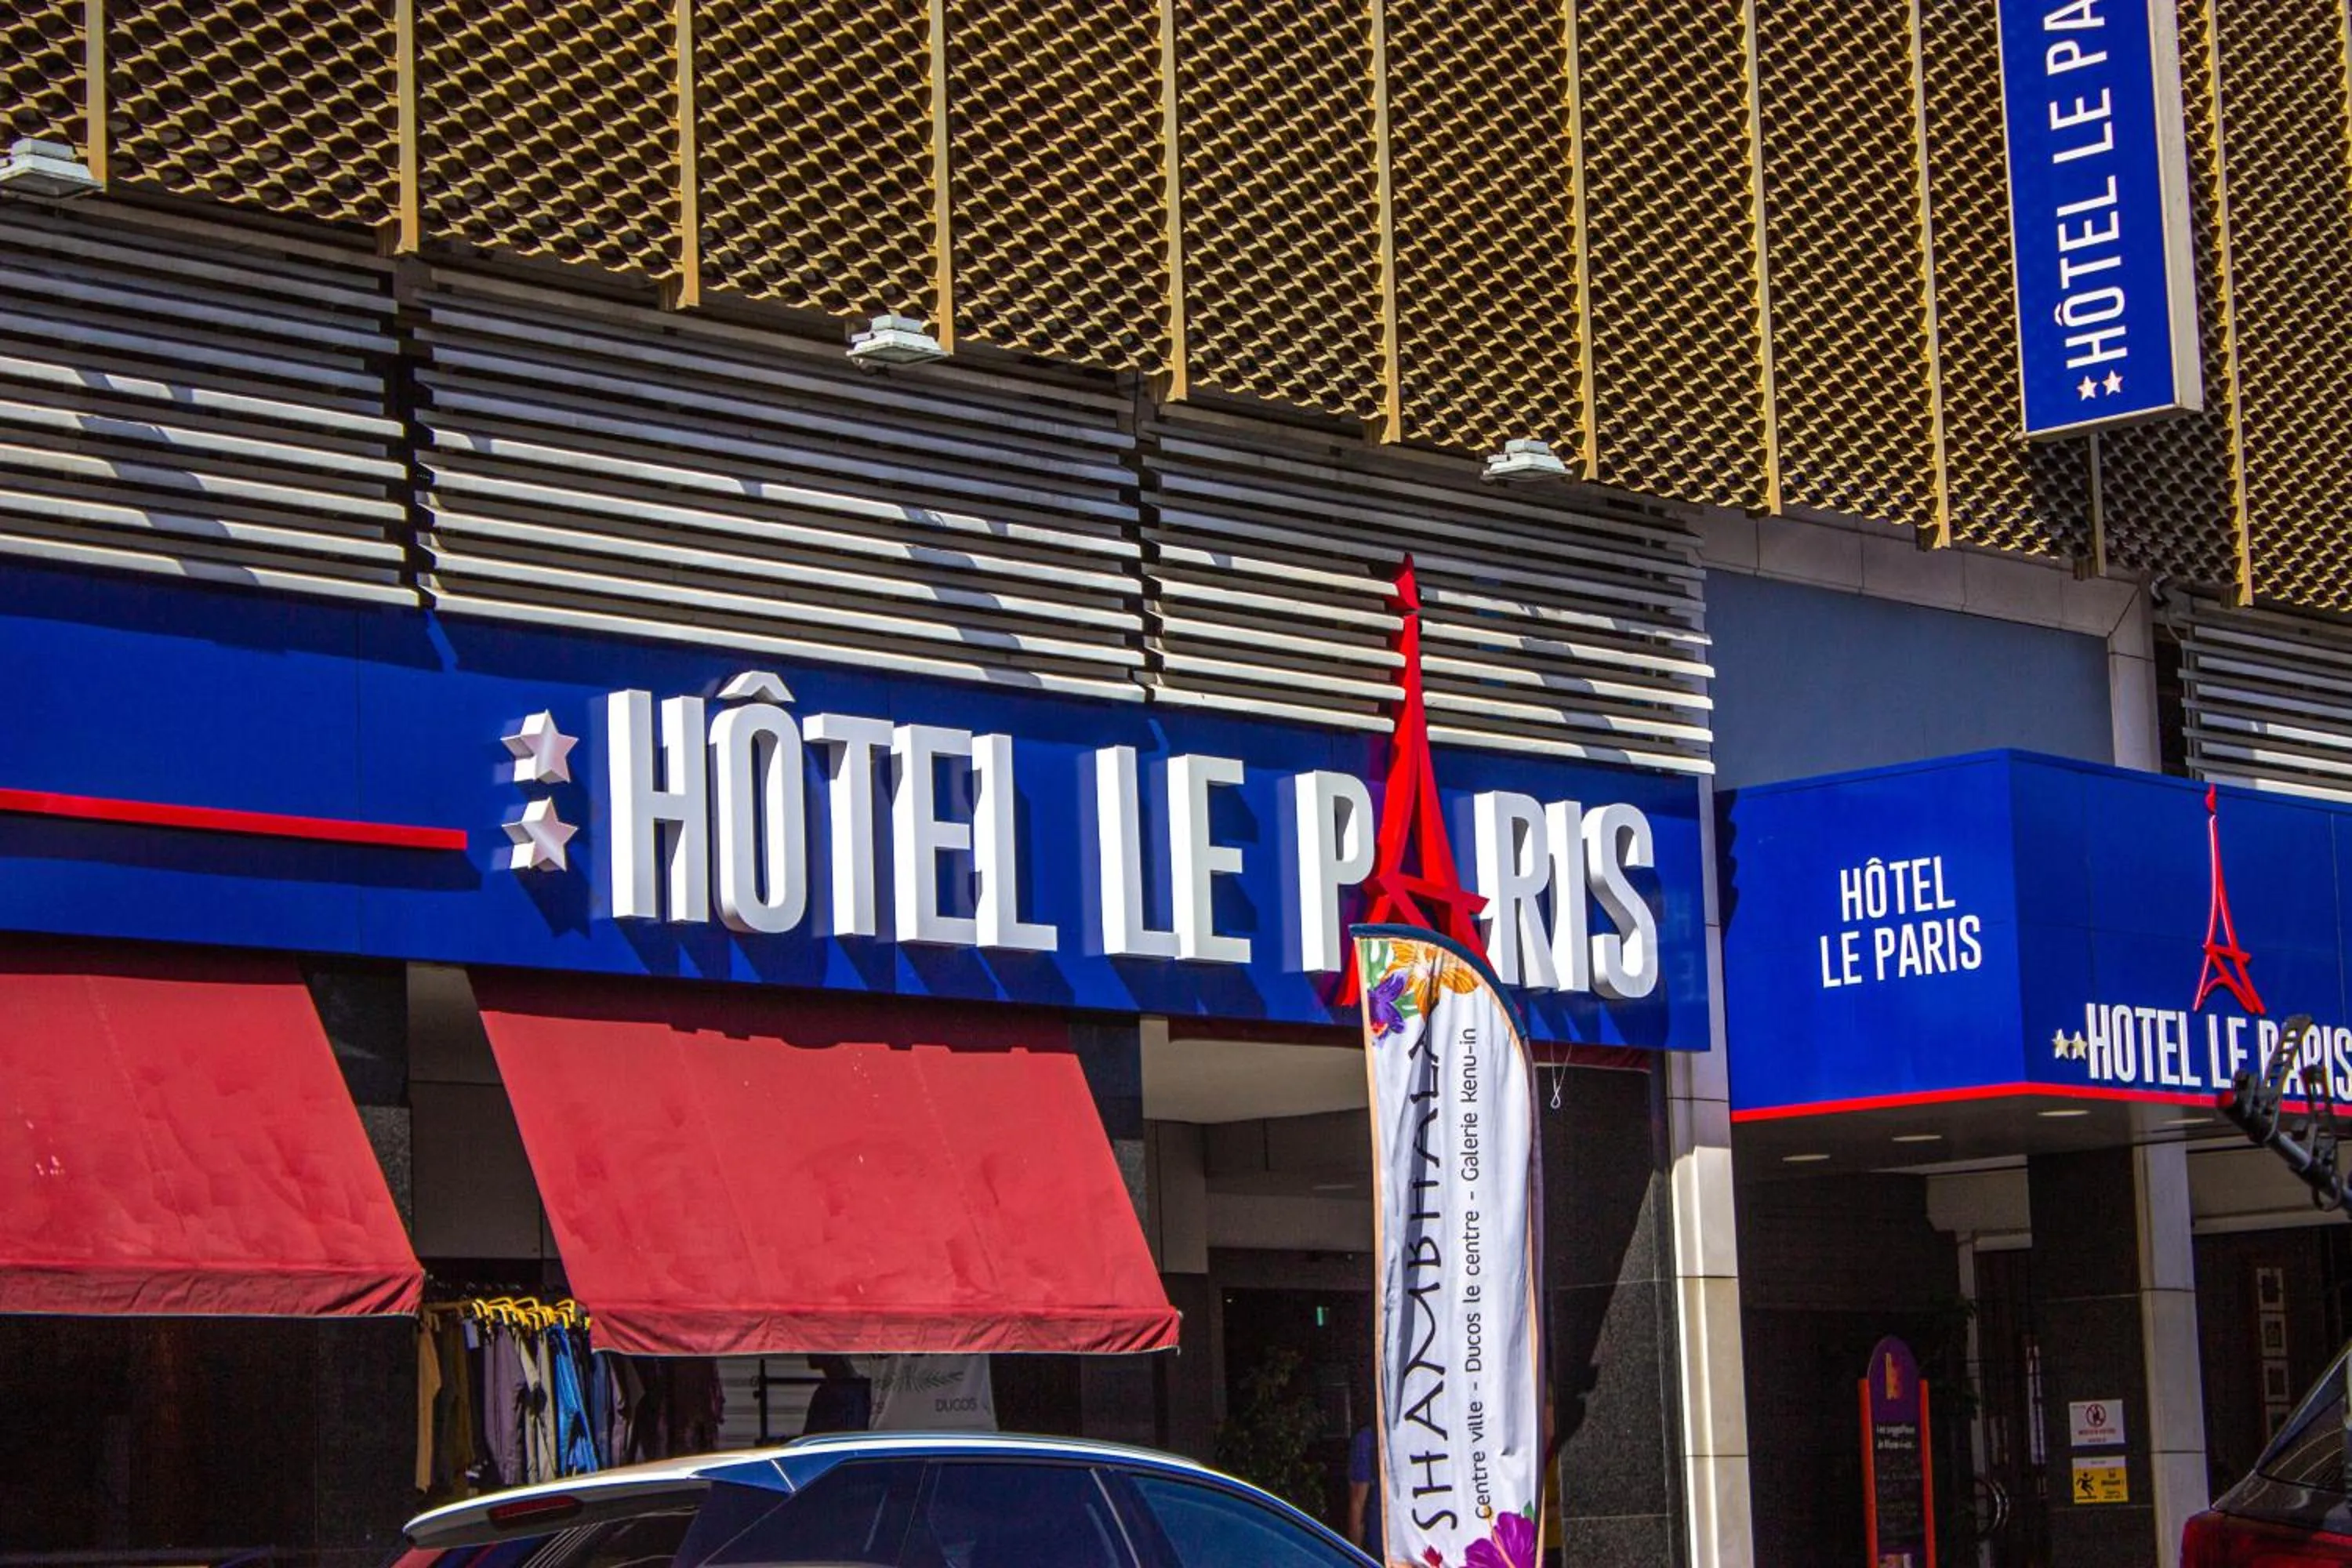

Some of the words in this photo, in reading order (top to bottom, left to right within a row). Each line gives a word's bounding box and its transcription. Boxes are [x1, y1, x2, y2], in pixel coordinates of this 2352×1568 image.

[2049, 87, 2114, 164] LE
[2054, 175, 2128, 368] HÔTEL
[608, 670, 1058, 952] HÔTEL
[1096, 745, 1251, 964] LE
[1839, 855, 1956, 922] HÔTEL
[1819, 930, 1862, 988] LE
[1875, 915, 1982, 980] PARIS
[1460, 1027, 1478, 1104] Kenu-in
[2085, 1002, 2201, 1087] HOTEL
[2208, 1014, 2249, 1089] LE
[1461, 1112, 1479, 1181] Galerie
[1461, 1210, 1481, 1277] centre
[1462, 1283, 1482, 1304] le
[1465, 1312, 1482, 1374] Ducos
[935, 1398, 978, 1413] DUCOS
[1468, 1401, 1484, 1443] ville
[1472, 1450, 1493, 1519] Centre
